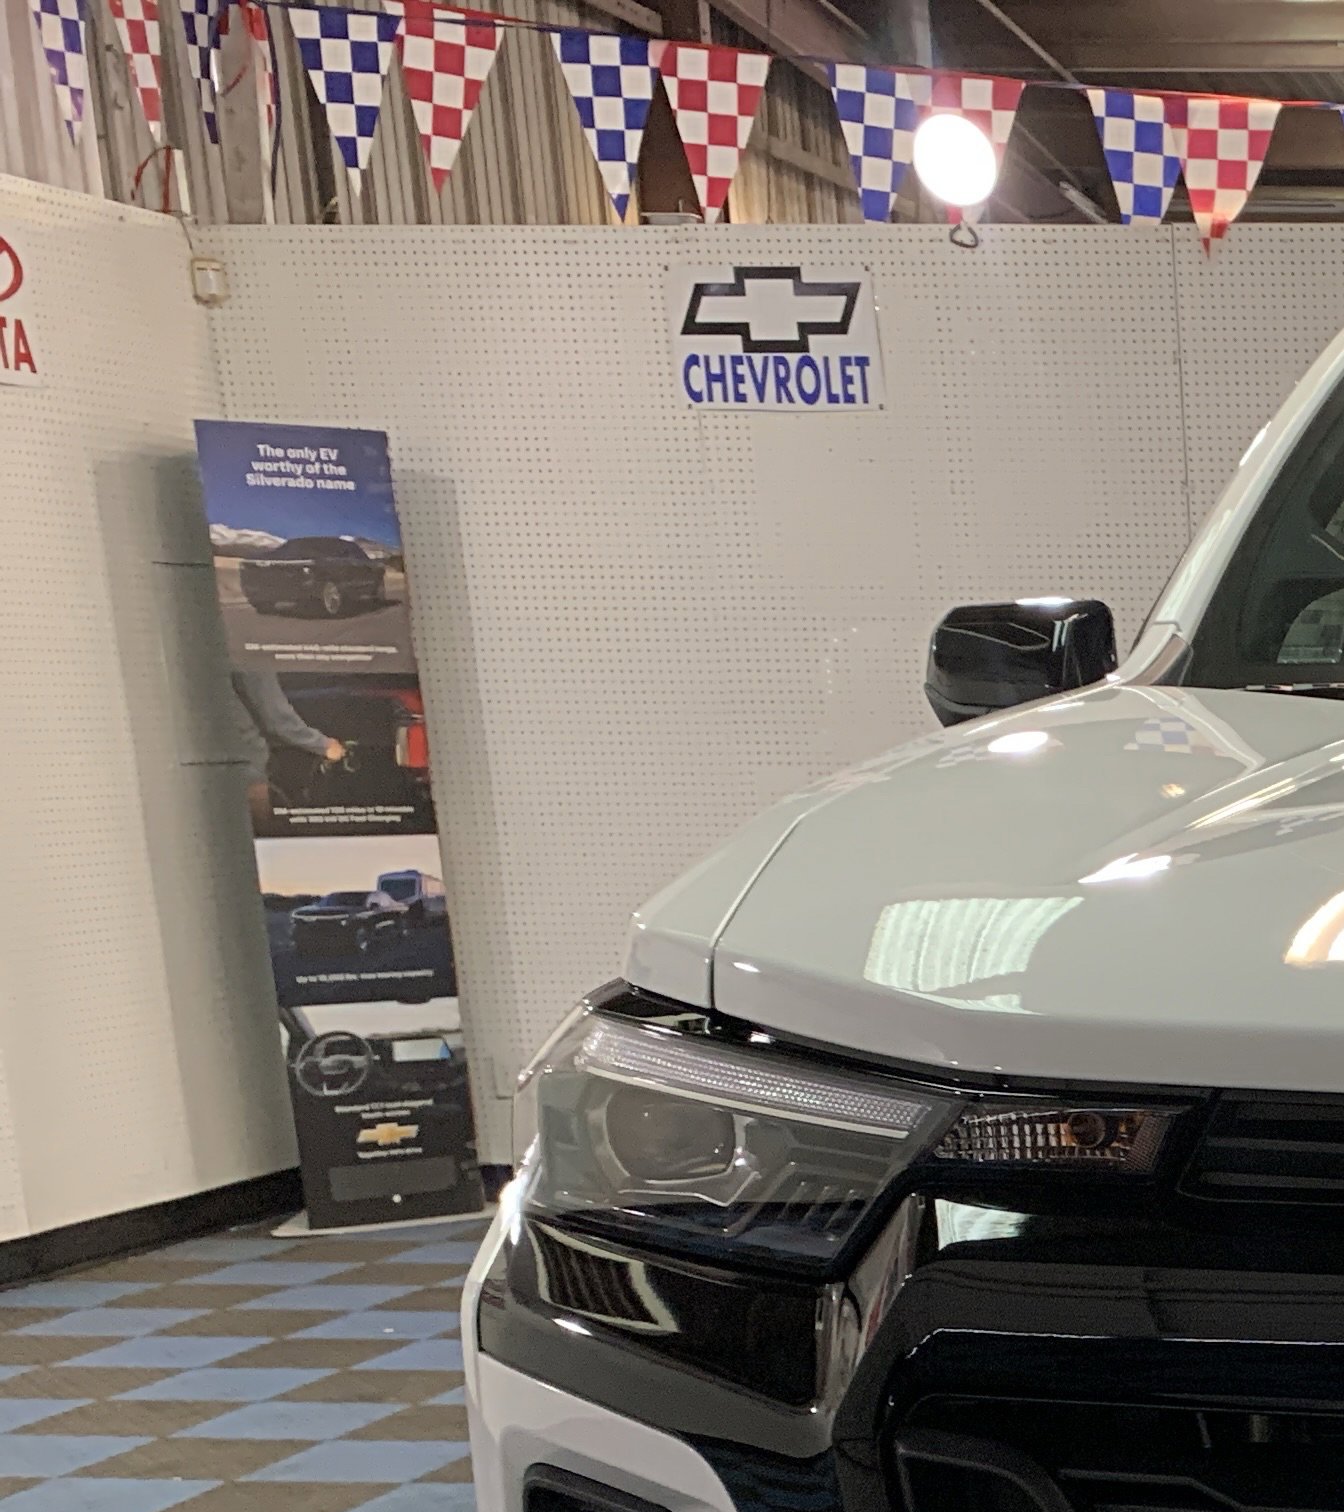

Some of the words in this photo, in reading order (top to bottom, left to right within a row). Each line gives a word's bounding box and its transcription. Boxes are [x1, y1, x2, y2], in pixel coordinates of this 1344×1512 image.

[683, 353, 870, 405] CHEVROLET
[256, 443, 284, 458] The
[286, 446, 317, 462] only
[319, 447, 338, 461] EV
[251, 460, 303, 475] worthy
[305, 461, 322, 474] of
[322, 463, 347, 476] the
[245, 473, 314, 488] Silverado
[316, 478, 356, 491] name
